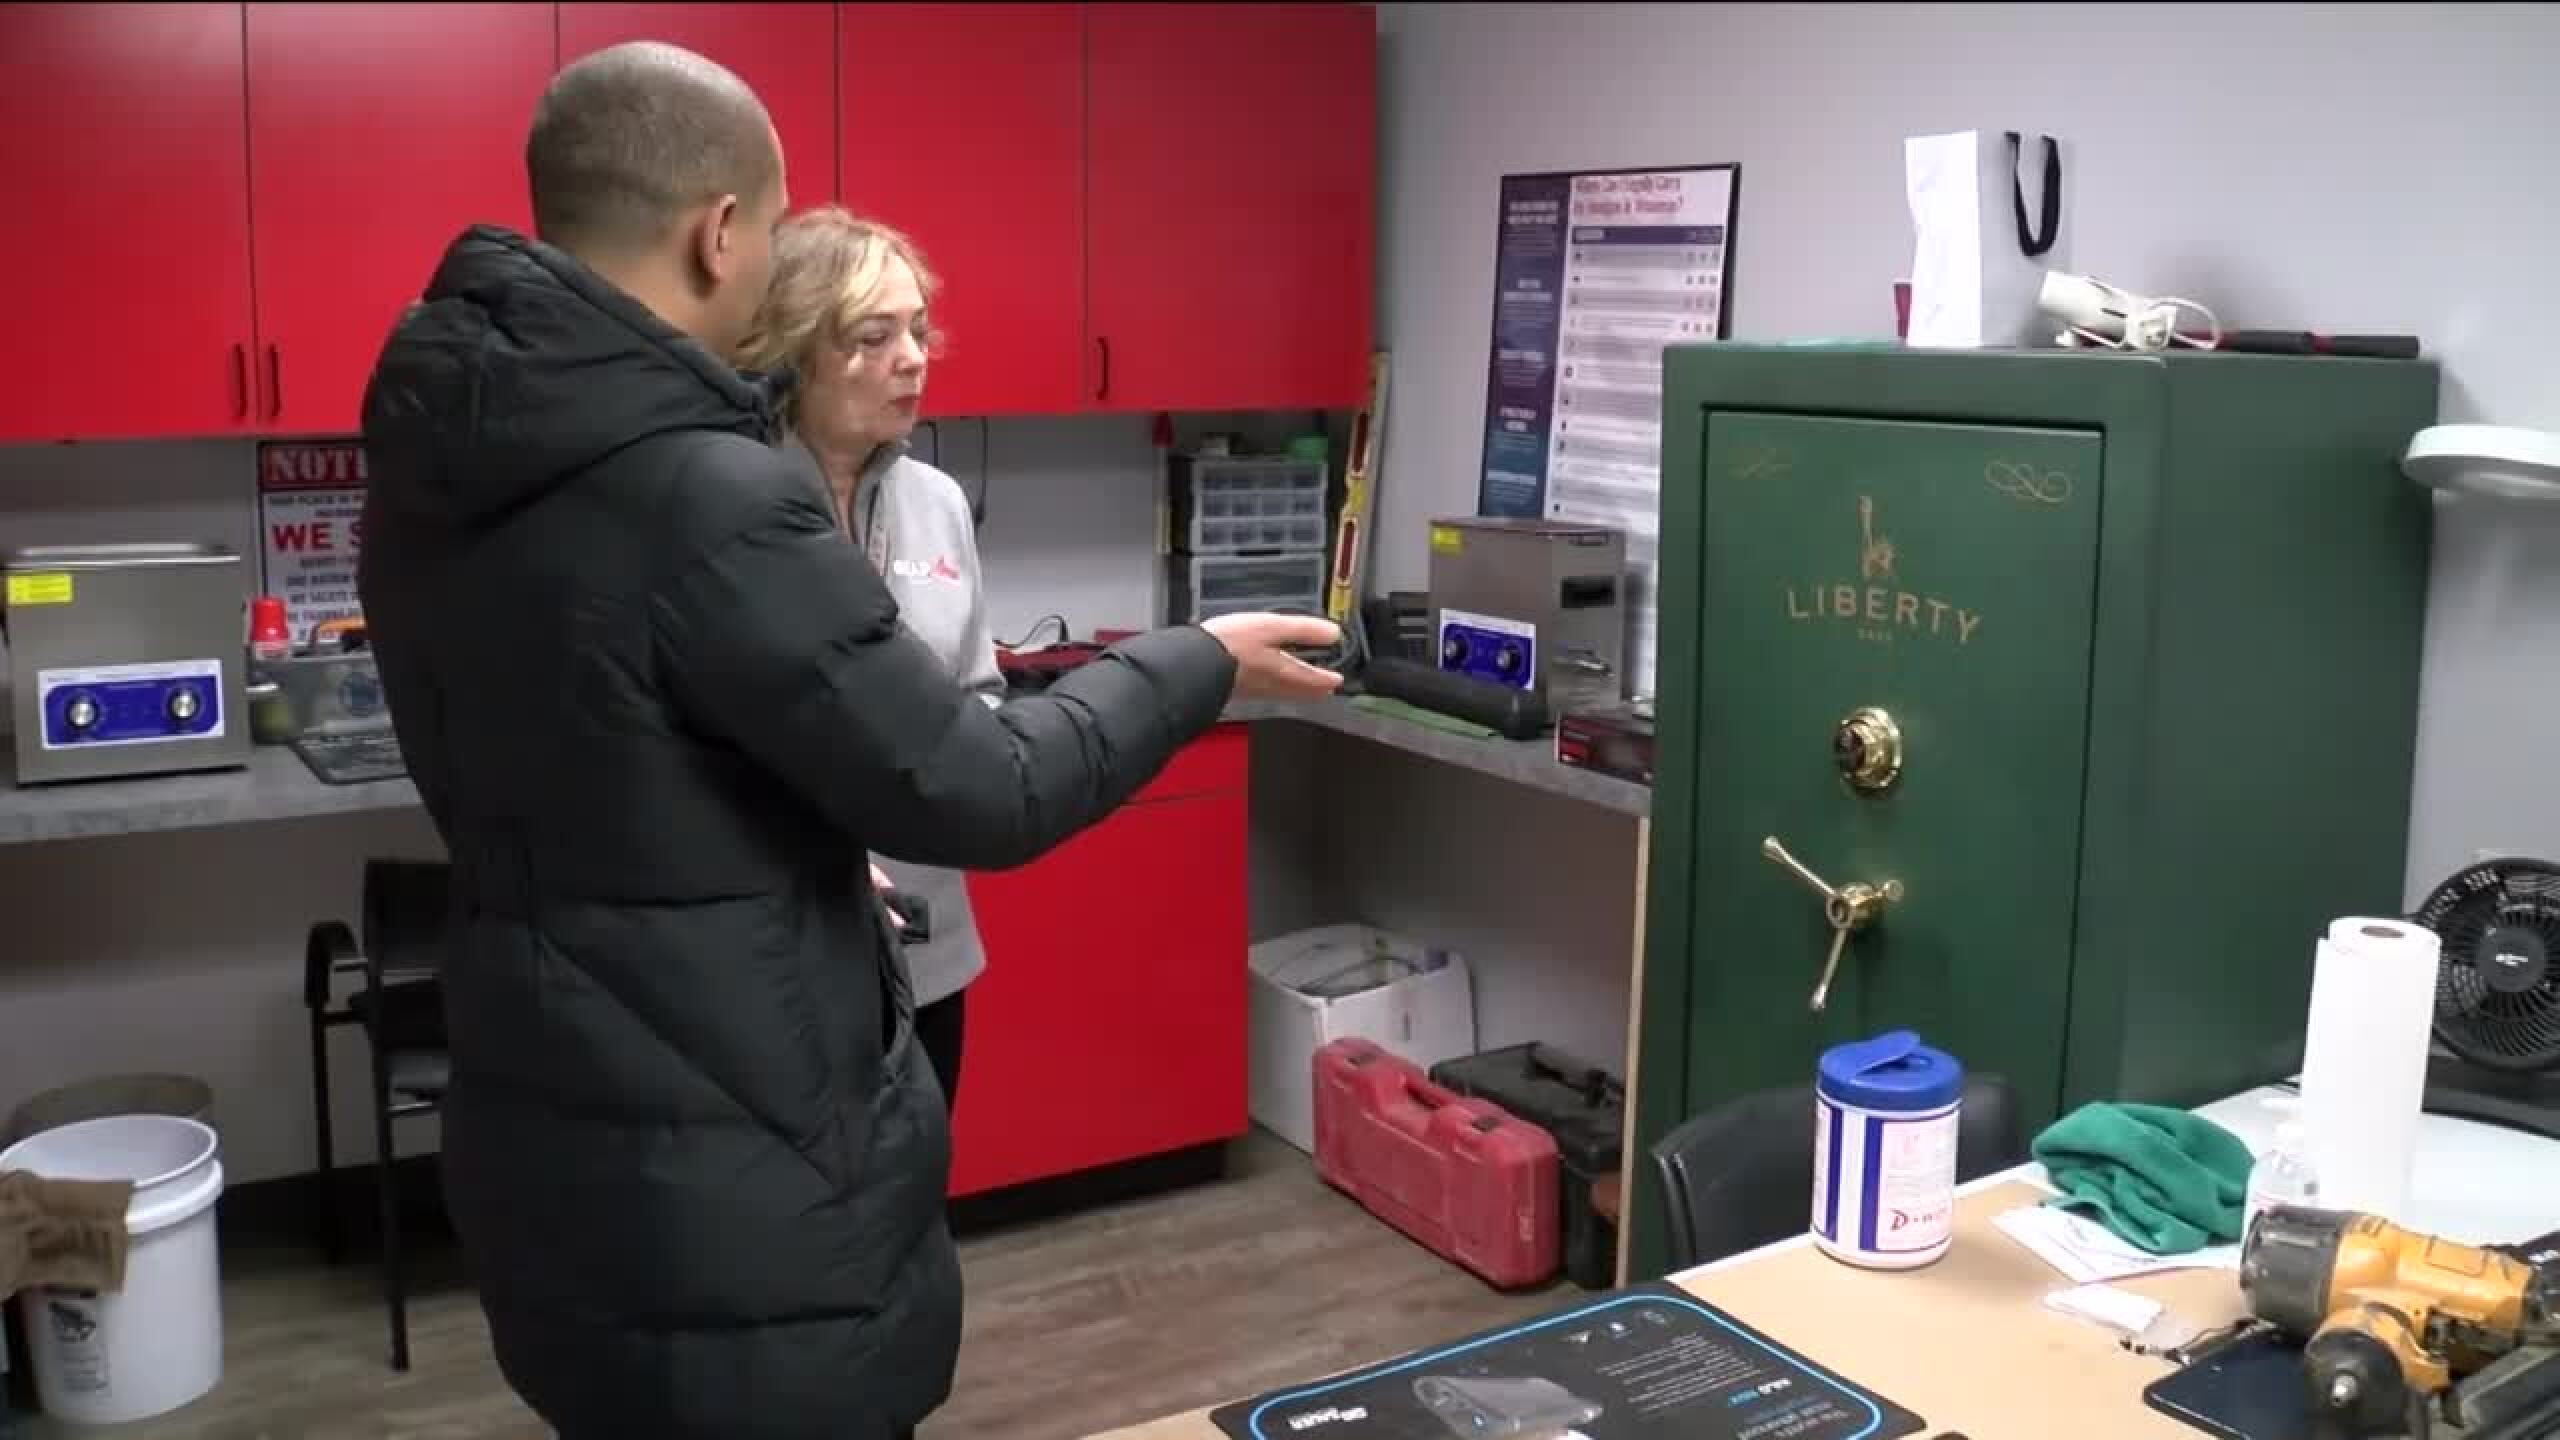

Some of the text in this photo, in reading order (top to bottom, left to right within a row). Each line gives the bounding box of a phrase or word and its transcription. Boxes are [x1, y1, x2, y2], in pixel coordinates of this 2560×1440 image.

[263, 448, 369, 481] NOTI
[272, 522, 334, 552] WE
[1786, 584, 1982, 645] LIBERTY
